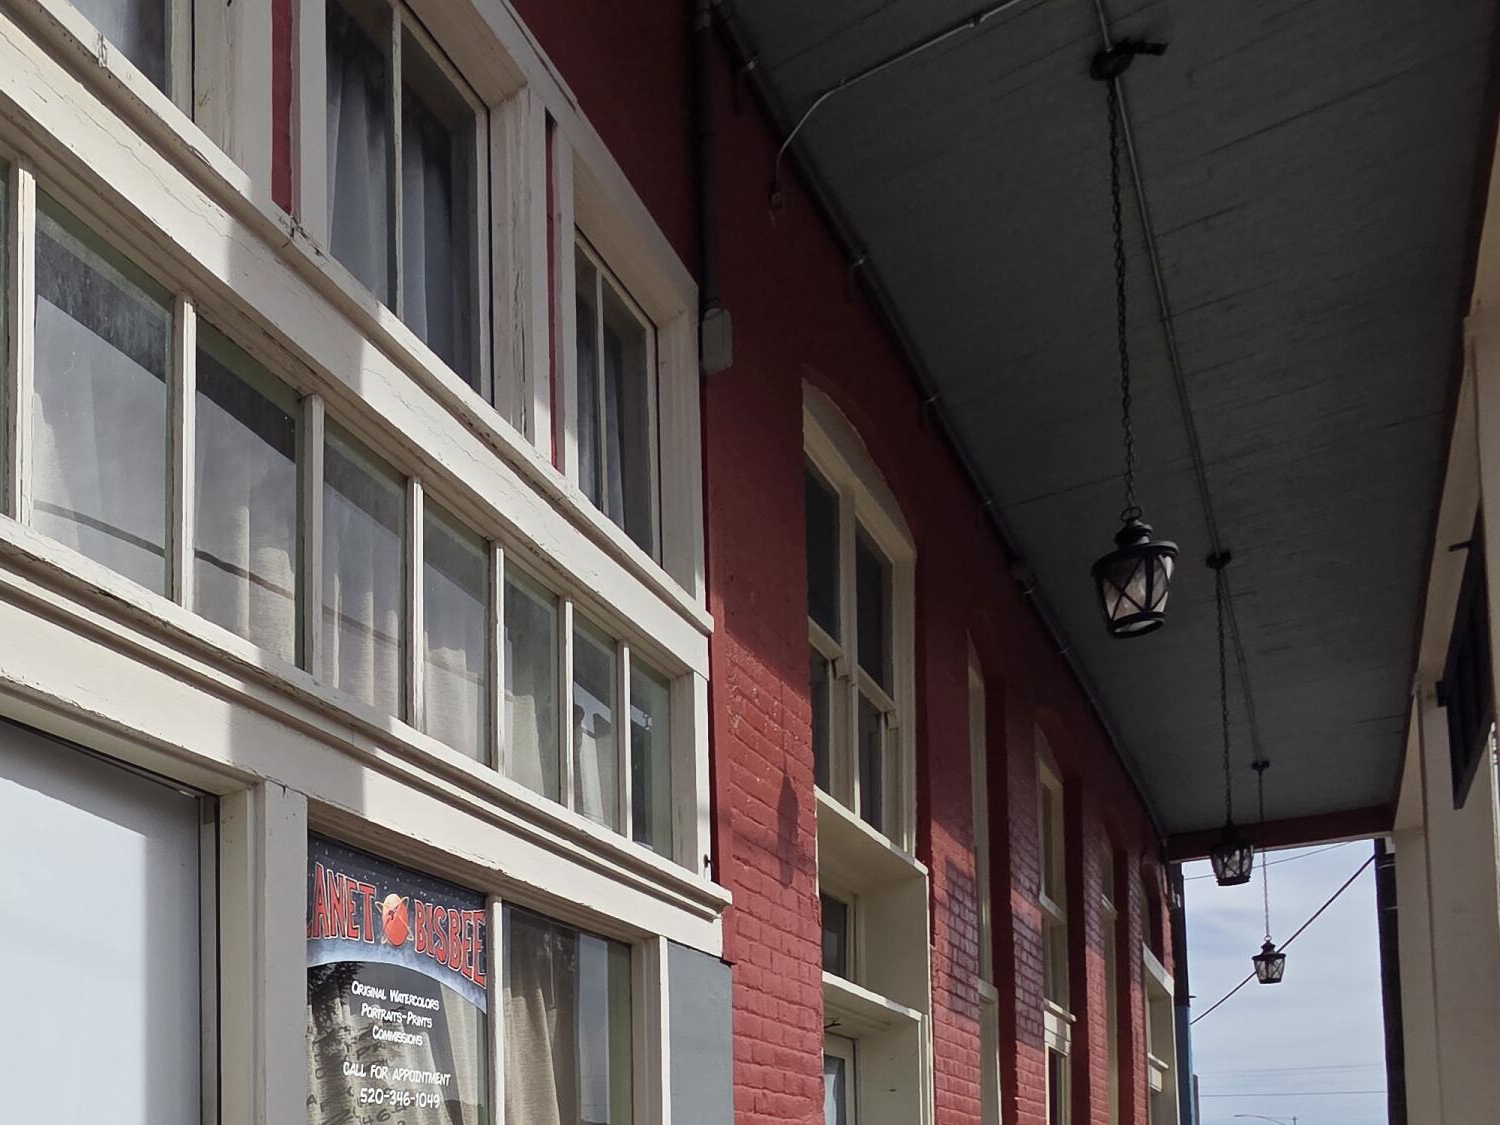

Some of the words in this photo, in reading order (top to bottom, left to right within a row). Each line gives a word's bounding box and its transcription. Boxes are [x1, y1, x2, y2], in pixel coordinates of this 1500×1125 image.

[307, 861, 376, 944] ANET
[414, 899, 486, 989] BISBEE
[351, 980, 387, 1000] ORIGINAL
[390, 989, 440, 1011] WATERCOLORS
[342, 1061, 367, 1078] CALL
[370, 1065, 390, 1080] FOR
[392, 1067, 451, 1087] APPOINTMENT
[360, 1087, 441, 1109] 520-346-1049
